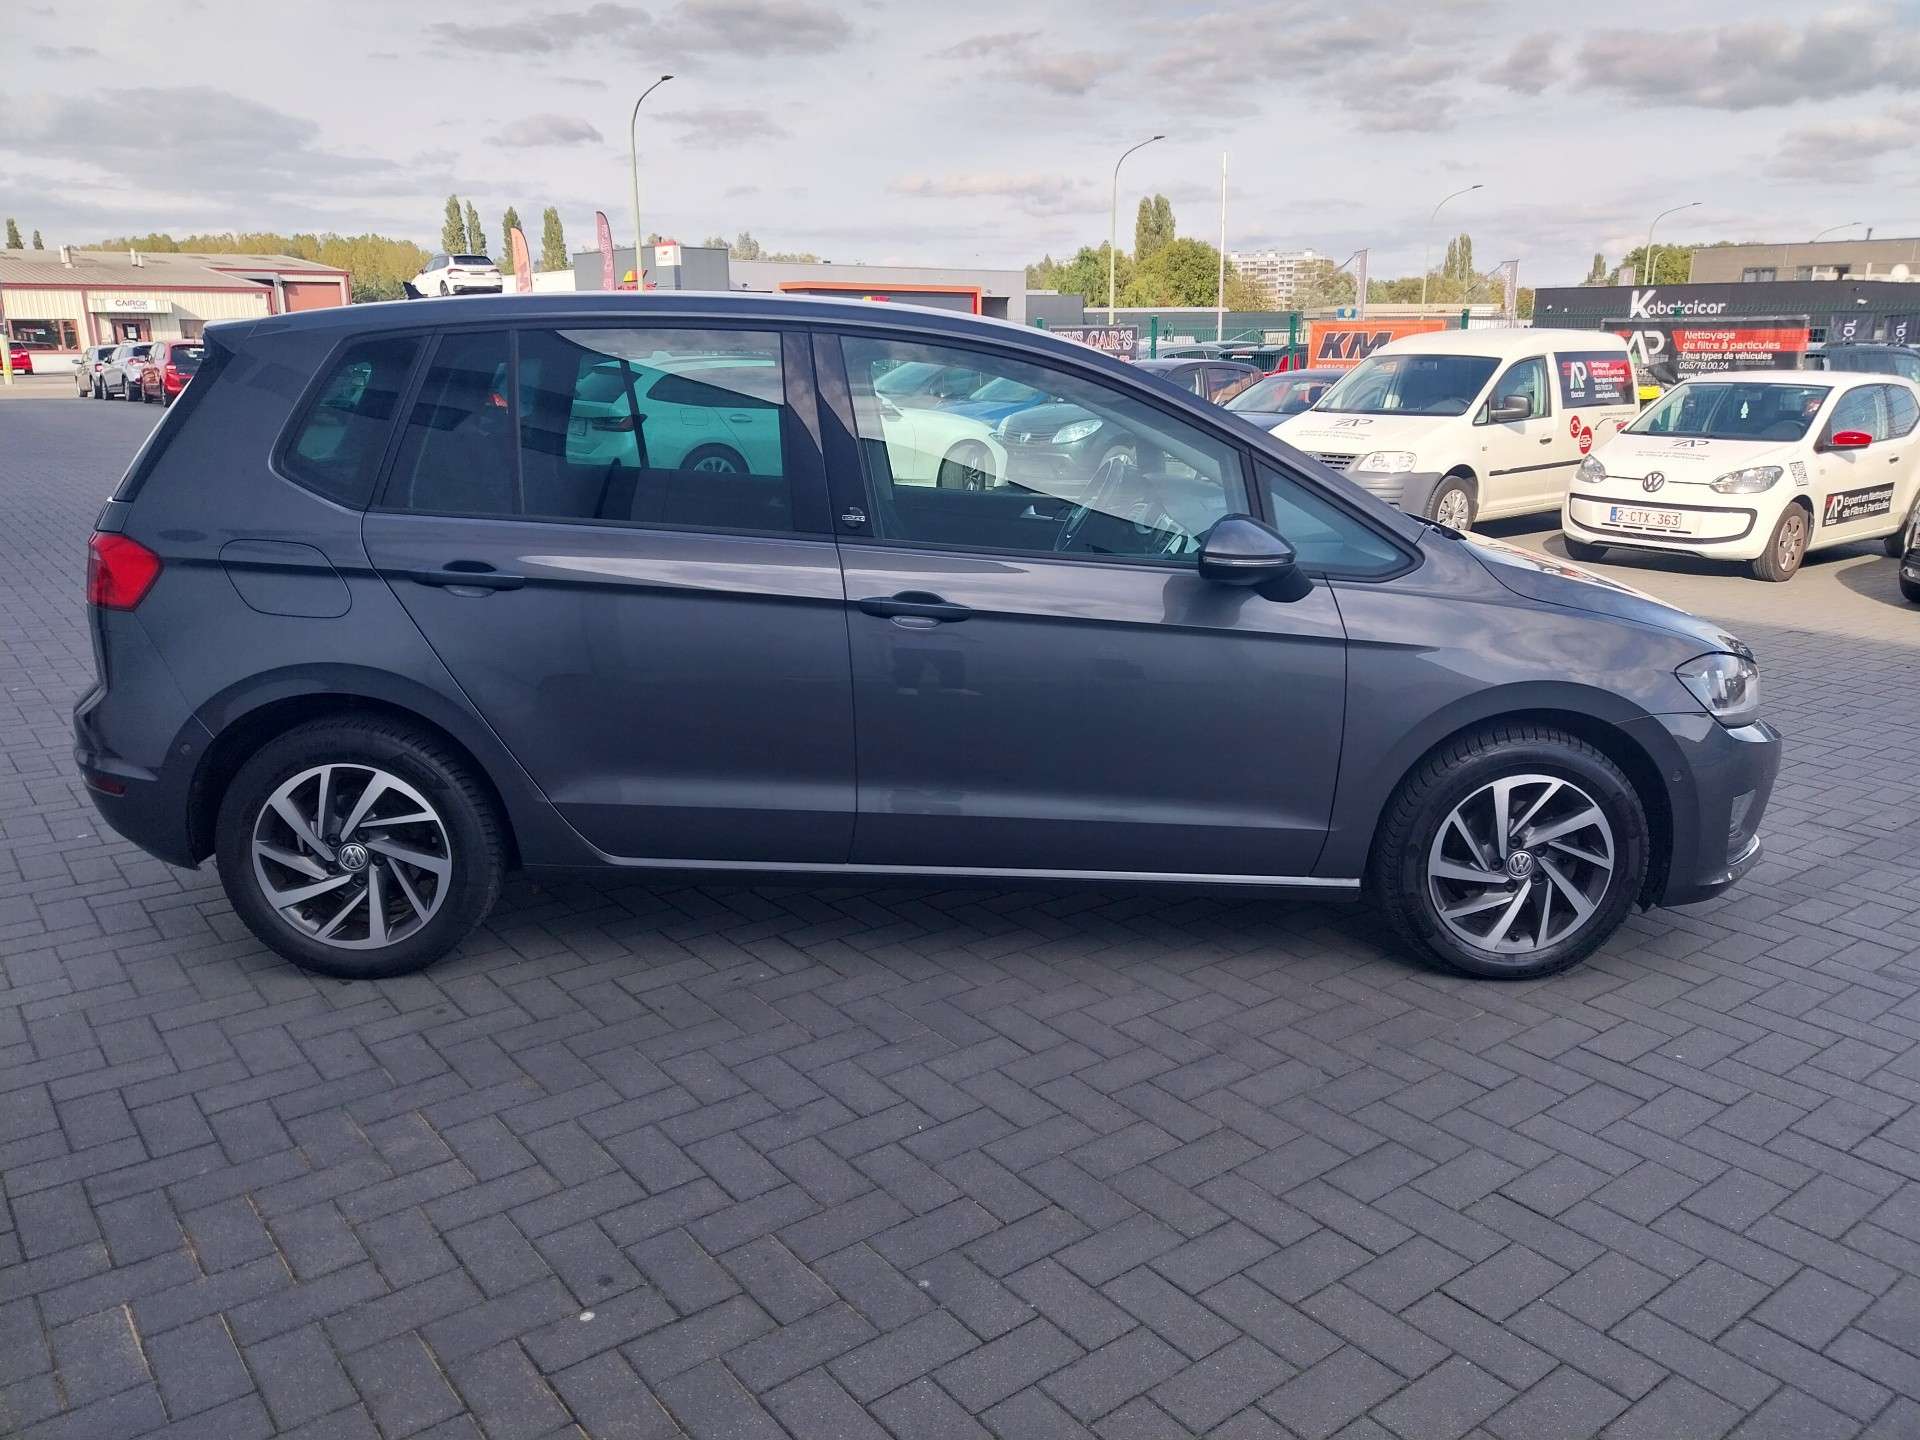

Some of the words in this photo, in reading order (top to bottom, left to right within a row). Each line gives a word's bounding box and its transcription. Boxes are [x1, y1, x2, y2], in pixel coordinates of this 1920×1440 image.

[1684, 331, 1736, 341] Nettoyage
[1682, 341, 1696, 350] de
[1697, 341, 1720, 350] filtre
[1730, 340, 1781, 351] particules
[1681, 351, 1701, 360] Tous
[1701, 352, 1723, 361] types
[1723, 351, 1734, 360] de
[1735, 351, 1773, 360] véhicules
[1679, 361, 1729, 370] 065/78.00.24
[1617, 510, 1679, 526] 2-CTX-363
